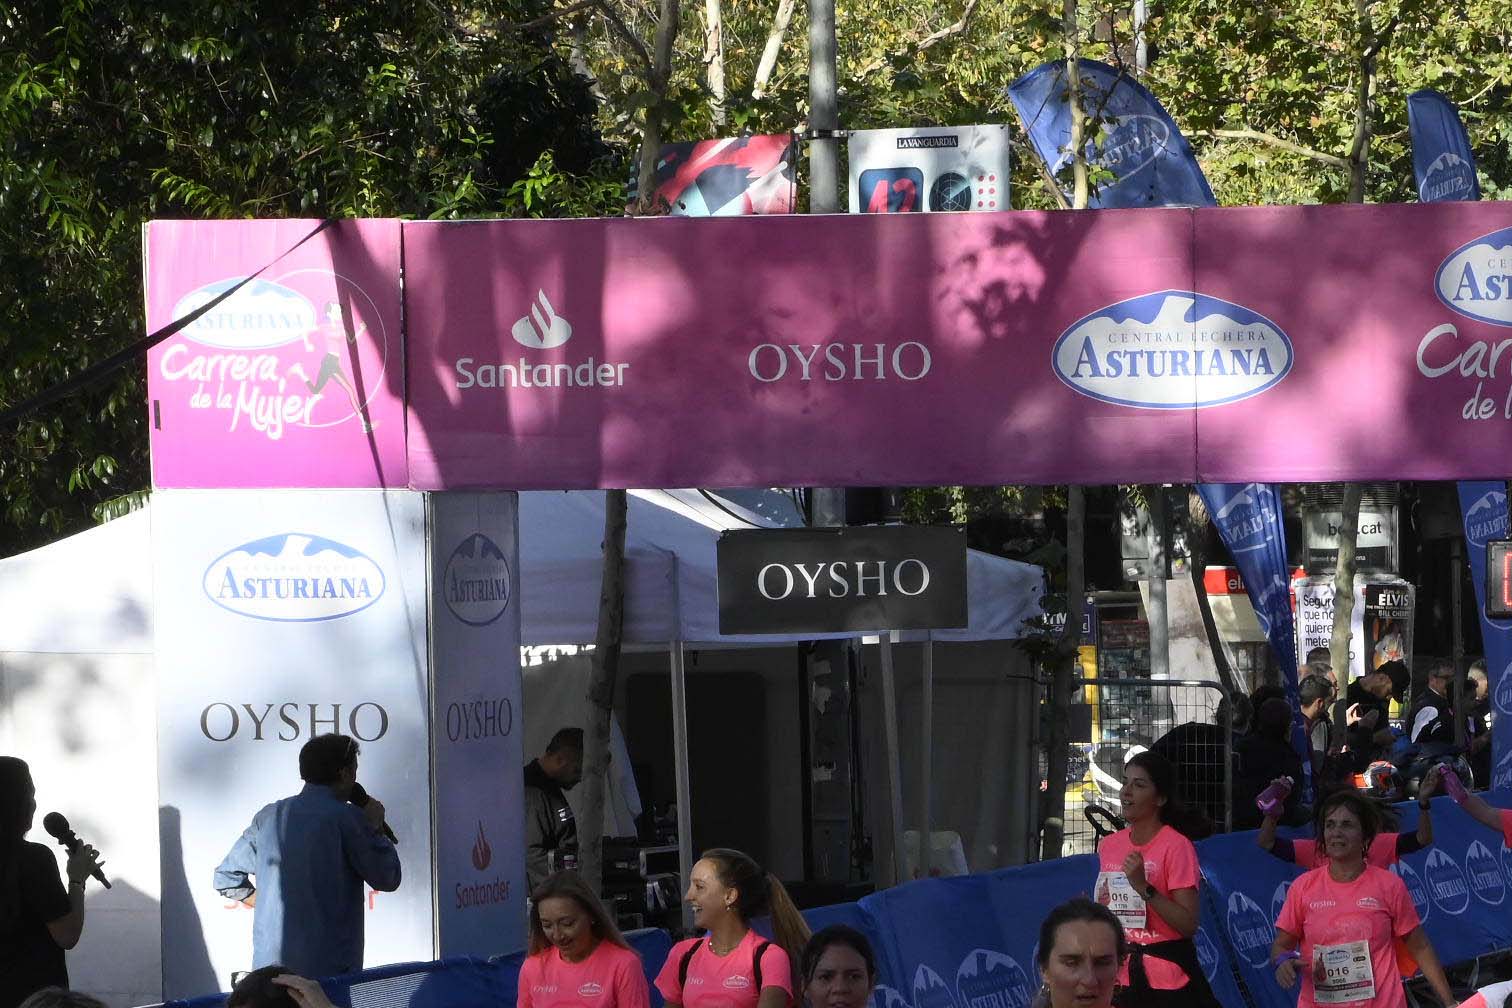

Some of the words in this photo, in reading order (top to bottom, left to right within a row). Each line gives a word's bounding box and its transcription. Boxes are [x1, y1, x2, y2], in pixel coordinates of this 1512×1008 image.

[1108, 330, 1183, 342] CENTRAL
[1190, 329, 1268, 342] LECHERA
[160, 343, 279, 382] Carrera
[454, 357, 630, 389] Santander
[748, 341, 932, 382] OYSHO
[1070, 333, 1275, 381] ASTURIANA
[190, 384, 211, 409] de
[217, 382, 233, 409] la
[229, 376, 324, 441] Mujer
[1462, 383, 1495, 421] de
[216, 566, 372, 600] ASTURIANA
[448, 568, 507, 601] ASTURIANA
[756, 557, 931, 601] OYSHO
[200, 702, 389, 743] OYSHO
[446, 697, 513, 743] OYSHO
[456, 877, 511, 910] Santander
[1111, 893, 1129, 902] 016
[1327, 966, 1350, 977] 016
